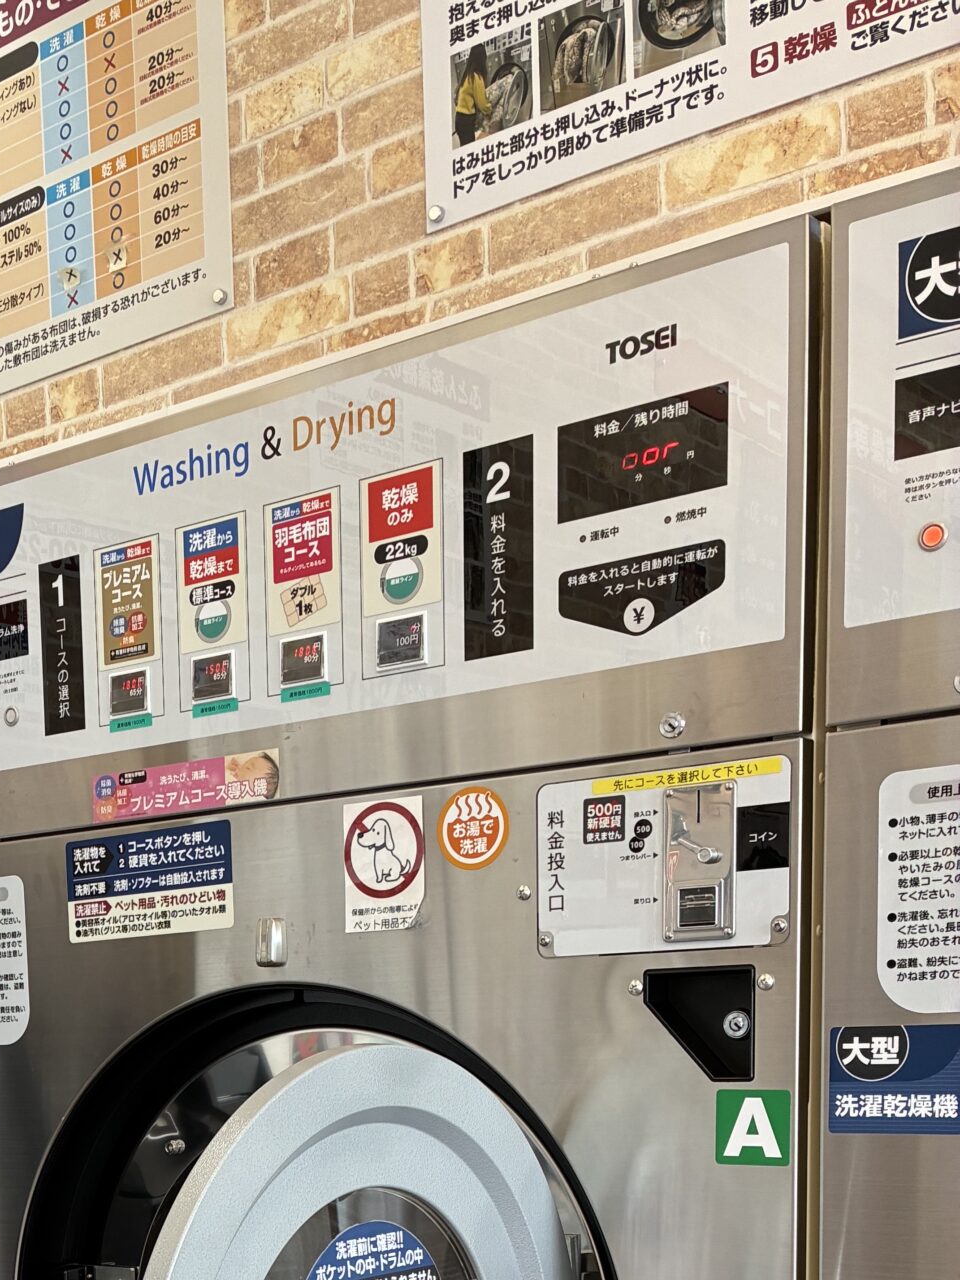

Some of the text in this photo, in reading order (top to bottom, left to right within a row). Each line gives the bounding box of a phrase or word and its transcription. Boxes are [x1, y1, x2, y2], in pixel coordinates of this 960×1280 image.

[50, 32, 75, 53] 洗濯
[755, 21, 838, 74] 5 乾燥
[452, 58, 728, 178] はみ出た部分も押し込み、ドーナツ状に。
[141, 123, 197, 160] 乾燥時間の目安
[453, 91, 725, 199] ドアをしっかり閉めて準備完了です。
[101, 155, 128, 178] 乾燥
[55, 179, 81, 199] 洗濯
[915, 252, 960, 305] 大
[605, 323, 678, 365] TOSEI
[133, 397, 396, 496] Washing & Drying
[382, 482, 419, 509] 乾燥
[387, 508, 413, 526] のみ
[675, 506, 708, 524] 燃焼中
[189, 528, 233, 552] 洗濯から
[274, 517, 330, 548] 羽毛布団
[590, 526, 620, 542] 運転中
[284, 543, 321, 563] コース
[385, 542, 417, 561] 22kg
[485, 461, 511, 638] 2 料金を入れる
[103, 563, 151, 590] プレミアム
[190, 556, 233, 579] 乾燥まで
[567, 545, 719, 587] 料金を入れると自動的に運転が
[111, 584, 143, 604] コース
[192, 584, 233, 605] 標準コース
[290, 584, 316, 599] ダブル
[603, 571, 679, 597] スタートします
[296, 600, 313, 616] 1枚
[51, 574, 70, 719] 1 コースの選択
[613, 763, 759, 791] 先にコースを選択して下さい
[131, 778, 268, 813] プレミアムコース導入機
[587, 802, 622, 818] 500円
[453, 819, 493, 838] お湯で
[587, 816, 621, 830] 新硬貨
[636, 825, 651, 833] 500
[128, 831, 211, 854] コースボタンを押し
[460, 837, 488, 855] 洗濯
[586, 830, 622, 842] 使えません
[630, 841, 643, 849] 100
[748, 831, 778, 843] コイン
[74, 847, 106, 861] 洗濯物を
[128, 845, 225, 869] 硬貨を入れてください
[547, 810, 565, 913] 料金投入口
[74, 860, 100, 875] 入れて
[74, 881, 106, 896] 洗剤不要
[898, 889, 956, 902] てください。
[76, 903, 106, 917] 洗濯禁止
[842, 1036, 900, 1066] 大型
[835, 1094, 958, 1120] 洗濯乾燥機
[723, 1097, 783, 1158] A
